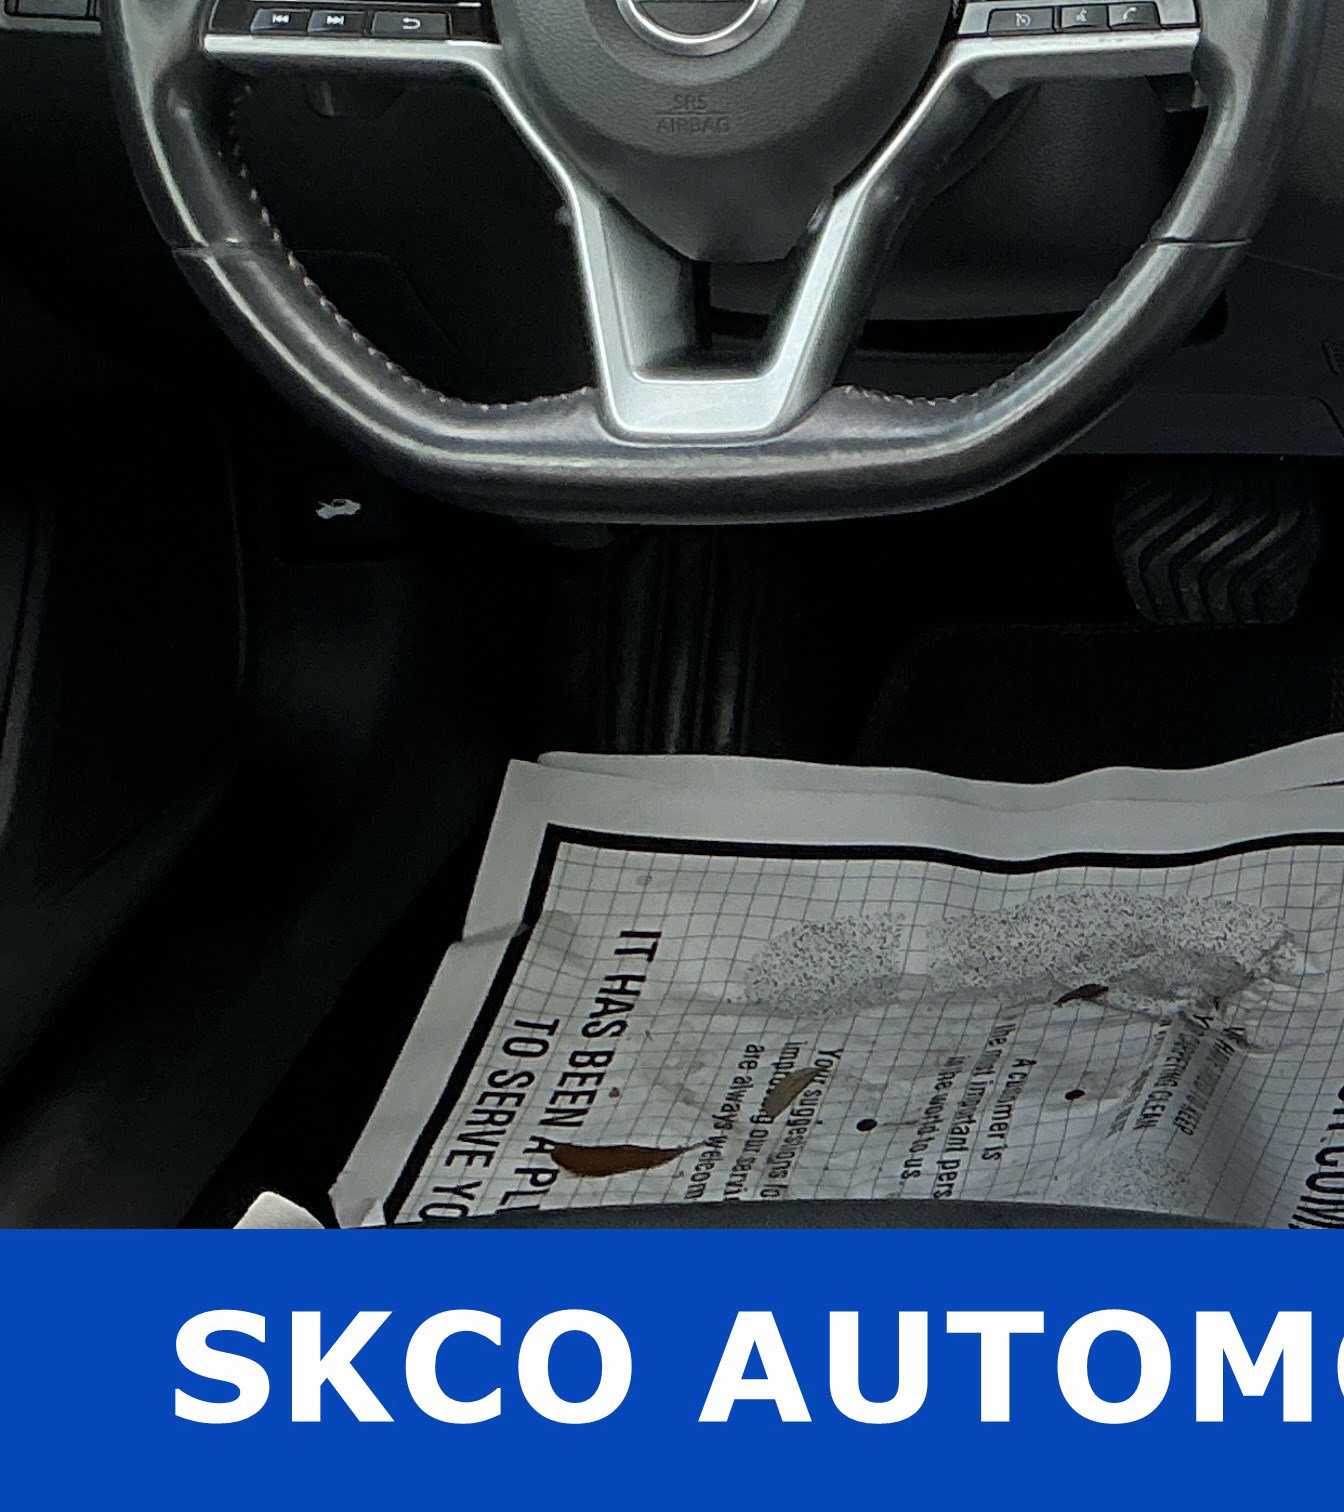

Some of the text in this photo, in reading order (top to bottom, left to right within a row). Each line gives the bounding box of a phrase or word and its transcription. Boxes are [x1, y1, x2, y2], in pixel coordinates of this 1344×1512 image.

[673, 93, 707, 109] SRS
[656, 118, 730, 134] AIRBAG
[613, 930, 662, 963] IT
[581, 974, 647, 1039] HAS
[502, 1018, 560, 1058] TO
[738, 1044, 766, 1070] are
[812, 1048, 844, 1085] Your
[538, 1050, 616, 1127] BEEN
[712, 1076, 755, 1130] always
[987, 1071, 1028, 1138] cumer
[445, 1069, 536, 1168] SERVE
[768, 1089, 823, 1178] suggestions
[522, 1135, 561, 1154] A
[743, 1129, 769, 1153] our
[981, 1144, 1009, 1162] is
